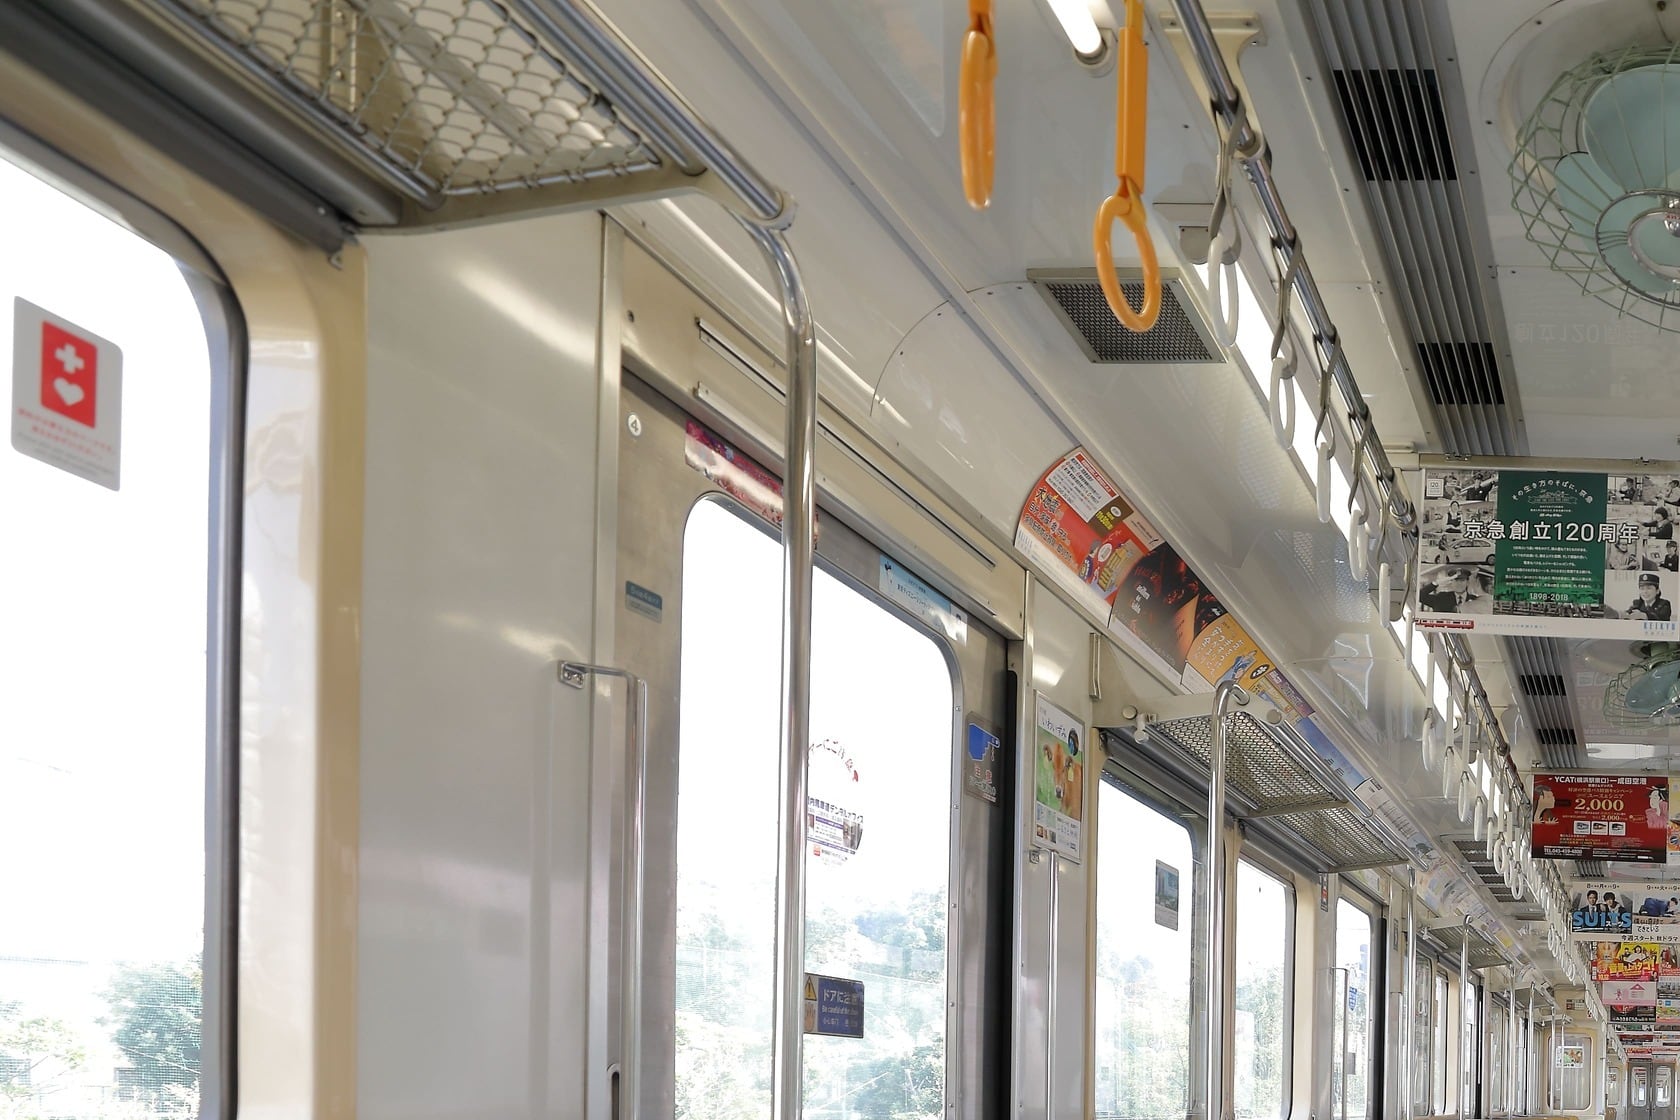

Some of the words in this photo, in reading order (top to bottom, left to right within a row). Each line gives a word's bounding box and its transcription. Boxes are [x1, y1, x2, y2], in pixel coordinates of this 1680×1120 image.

[1463, 519, 1640, 544] 京急創立120周年
[1574, 798, 1625, 812] 2,000
[1572, 911, 1632, 928] SUITS
